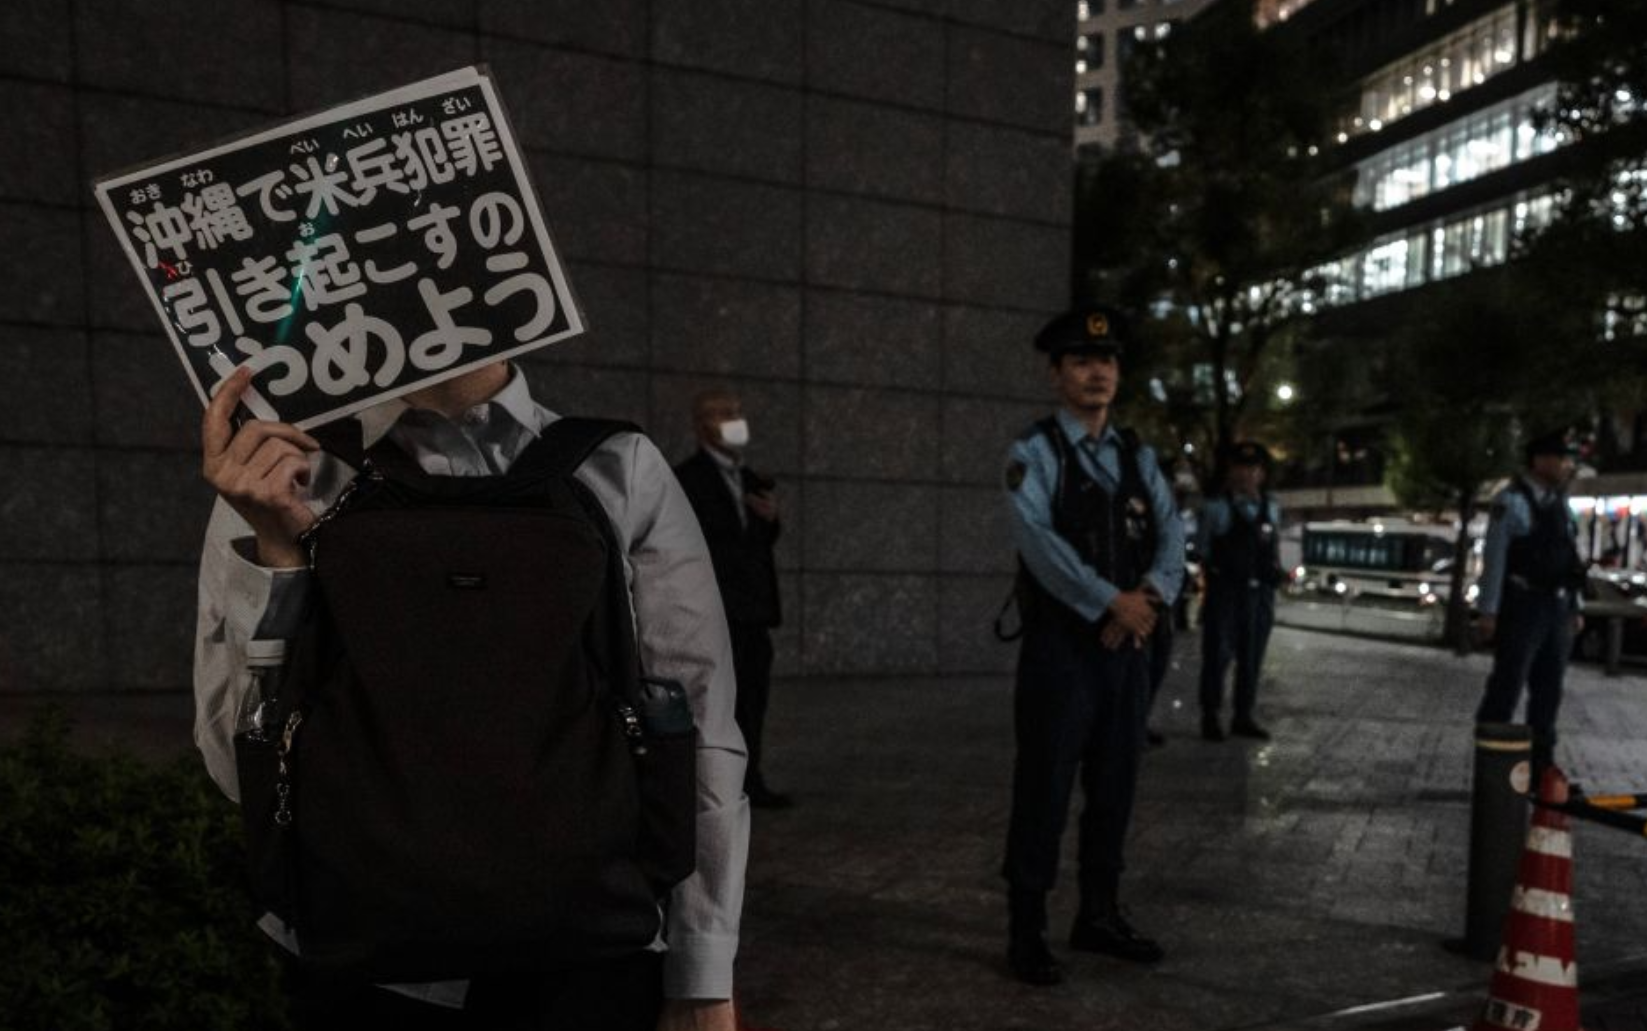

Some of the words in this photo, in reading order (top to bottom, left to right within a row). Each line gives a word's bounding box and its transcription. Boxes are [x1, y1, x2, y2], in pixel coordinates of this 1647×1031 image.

[125, 111, 504, 269] 沖縄で米兵犯罪
[129, 183, 161, 204] おき
[180, 168, 213, 188] なわ
[342, 121, 374, 139] へい
[392, 107, 424, 128] はん
[442, 96, 472, 115] ざい
[163, 191, 525, 348] 引き起こすの
[207, 250, 557, 423] やめよう
